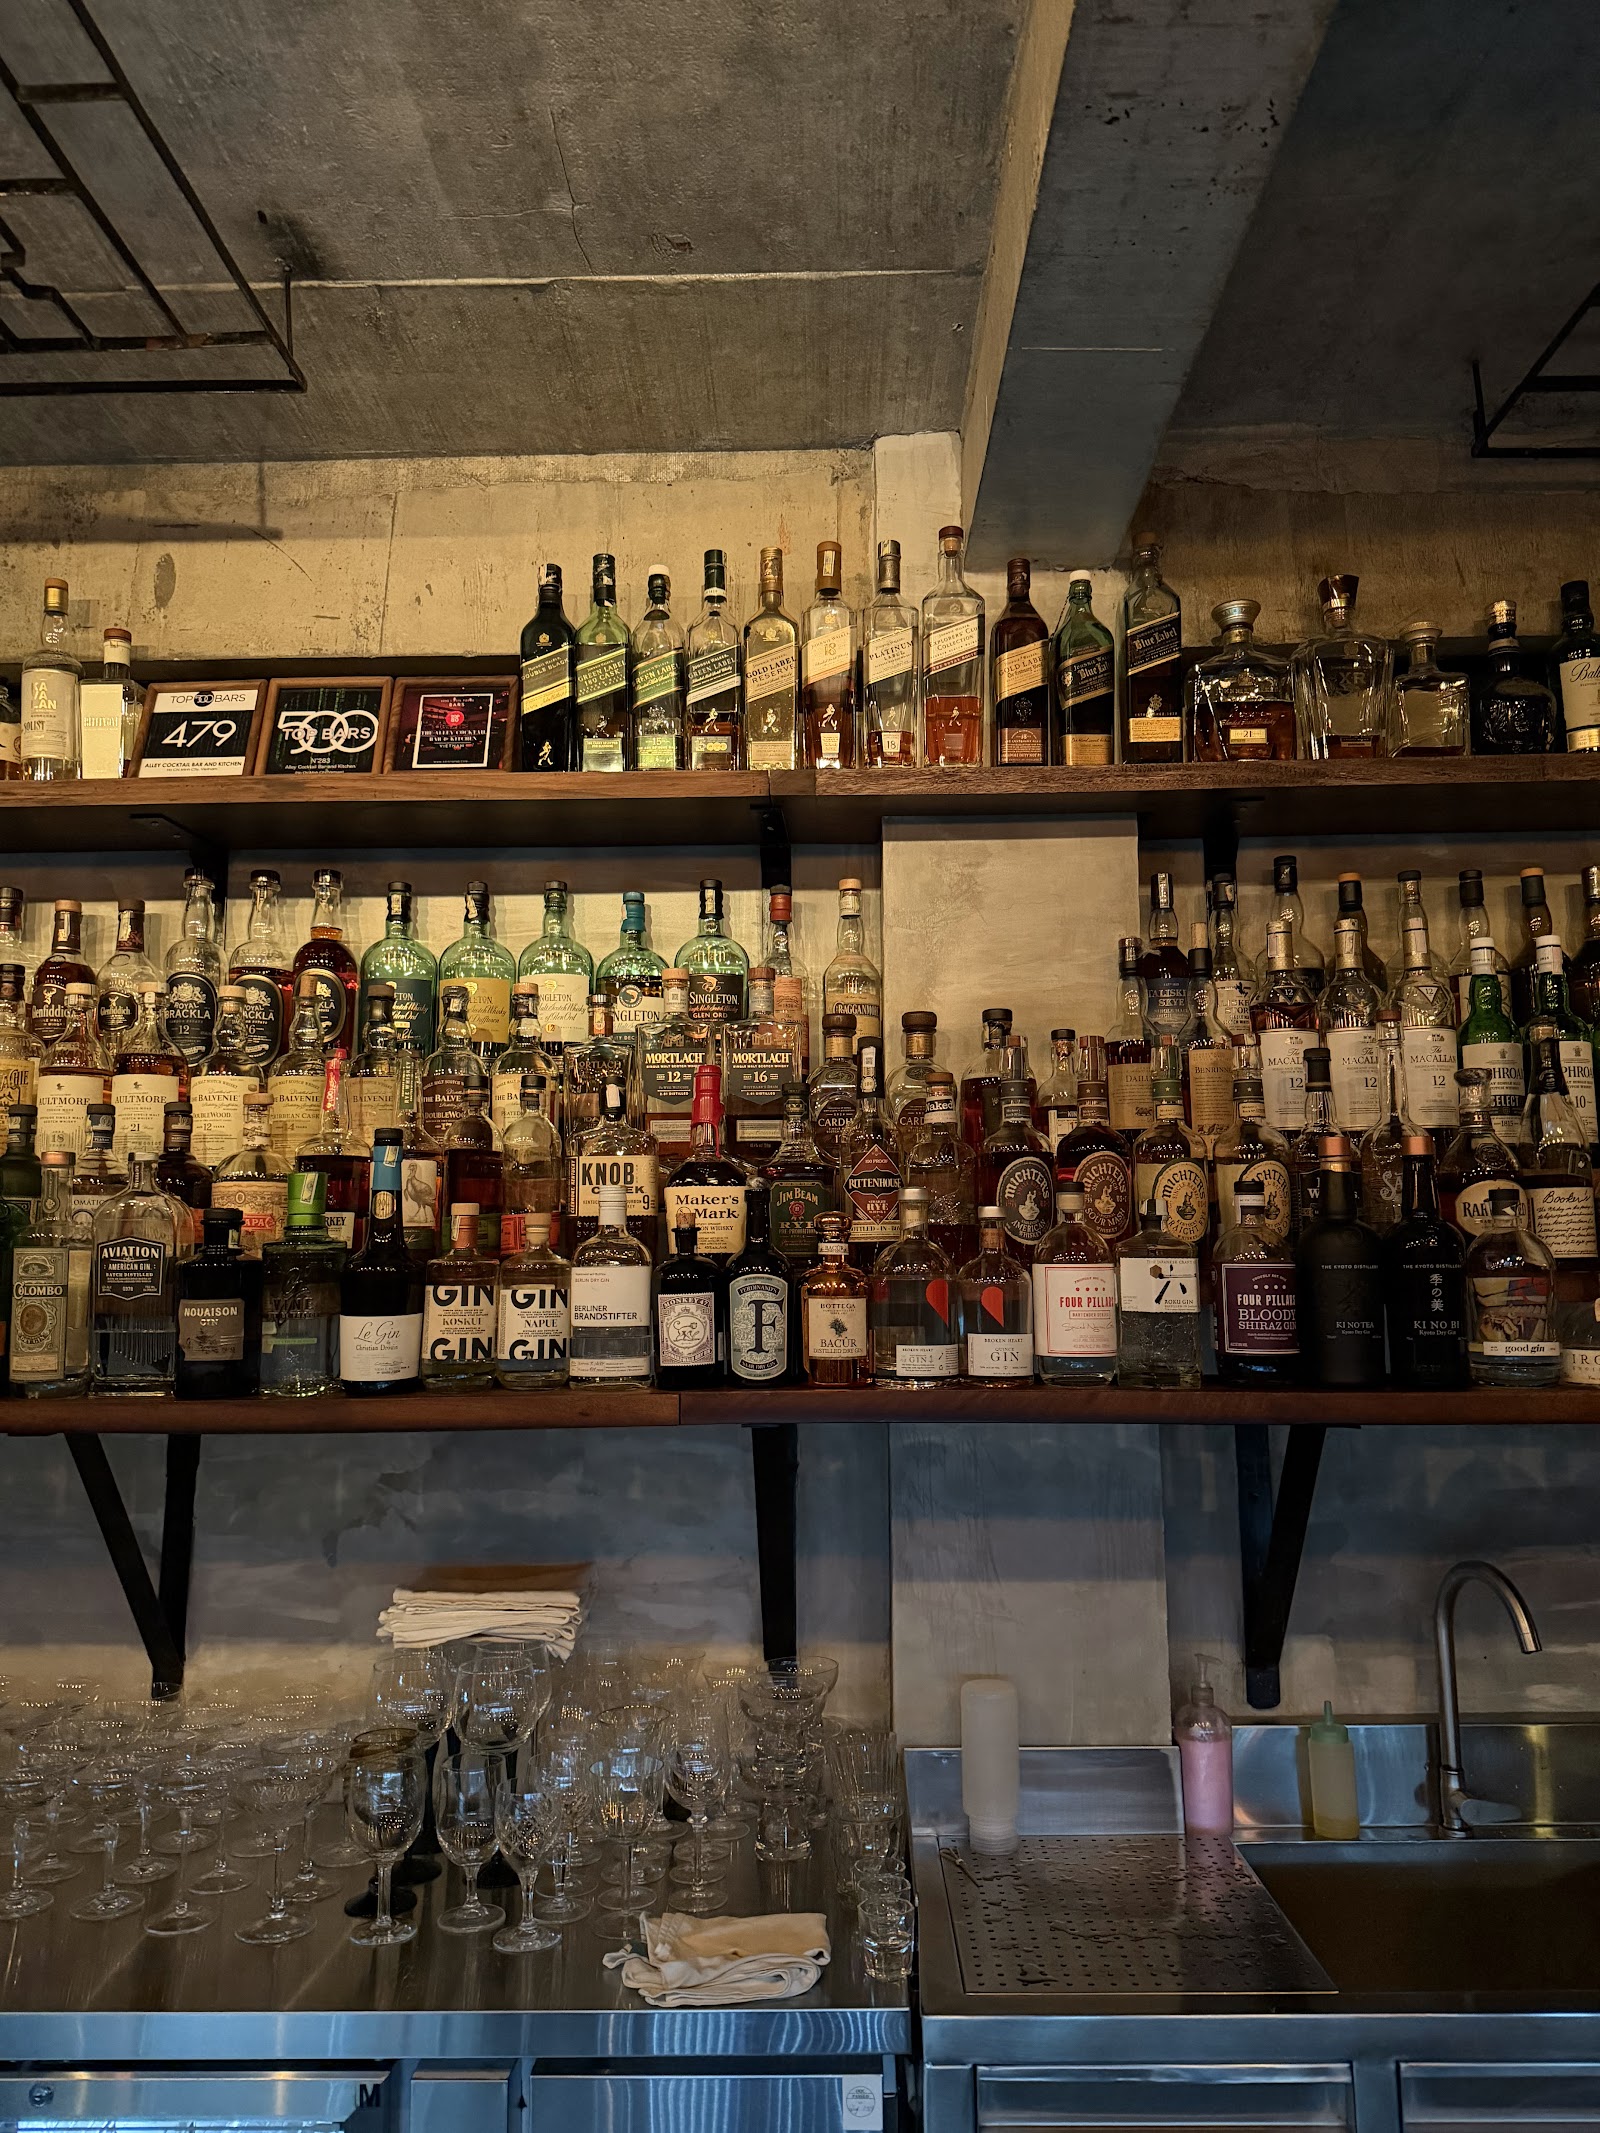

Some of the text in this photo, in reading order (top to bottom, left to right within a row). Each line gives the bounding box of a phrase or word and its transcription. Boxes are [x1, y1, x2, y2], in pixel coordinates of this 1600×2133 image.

[937, 634, 974, 650] COLLECTION
[1133, 627, 1178, 651] Blue Label
[869, 640, 914, 660] PLATINUM
[521, 657, 569, 680] DOUBLE BLACK
[578, 660, 626, 681] GREEN LABEL
[688, 666, 712, 679] GREEN
[714, 658, 736, 669] LABEL
[745, 665, 768, 679] GOLD
[769, 656, 796, 670] LABEL
[752, 664, 795, 683] RESERVE
[1077, 667, 1097, 681] Blue
[1339, 671, 1366, 685] XR
[171, 694, 246, 704] TOP BARS
[161, 720, 237, 748] 479
[277, 709, 379, 755] 500
[282, 727, 371, 740] TOP BARS
[886, 740, 897, 750] 18
[689, 991, 739, 1005] SINGLETON
[174, 1001, 200, 1010] ROYAL
[613, 1010, 660, 1022] NGLETON
[178, 1025, 190, 1035] 12
[645, 1053, 706, 1064] MORTLACH
[732, 1052, 792, 1064] MORTLACH
[666, 1071, 681, 1083] 12
[753, 1071, 768, 1083] 16
[1289, 1077, 1304, 1088] 12
[1364, 1076, 1378, 1088] 12
[1431, 1074, 1446, 1086] 12
[38, 1097, 91, 1106] AULTMORE
[115, 1095, 167, 1104] AULTMORE
[198, 1094, 239, 1102] BALVENIE
[279, 1094, 320, 1103] BALVENIE
[353, 1095, 394, 1103] BALVENIE
[1575, 1095, 1586, 1108] 10
[130, 1123, 140, 1132] 21
[203, 1123, 213, 1131] 12
[51, 1133, 65, 1144] 18
[582, 1162, 635, 1186] KNOB
[592, 1186, 645, 1194] CEK
[848, 1178, 901, 1190] RITTENHOUSE
[1004, 1168, 1050, 1200] MICHTER'S
[1162, 1169, 1206, 1200] MICHTER'S
[642, 1194, 650, 1211] 9
[675, 1194, 740, 1206] Maker's
[776, 1187, 818, 1207] JIM BEAM
[866, 1203, 889, 1211] RYE
[694, 1208, 739, 1219] Mark
[1084, 1207, 1126, 1227] SOUR MASH
[779, 1221, 814, 1229] RYE
[1011, 1219, 1047, 1232] AMERICAN
[1019, 1230, 1042, 1239] WHISKEY
[101, 1246, 160, 1259] AVIATION
[13, 1282, 63, 1300] COLOMBO
[739, 1284, 778, 1295] FERDINAND'S
[1429, 1273, 1444, 1312] 季の美
[432, 1285, 494, 1307] GIN
[511, 1290, 568, 1309] GIN
[1237, 1294, 1261, 1306] FOUR
[663, 1297, 710, 1309] MONKEY 47
[1060, 1297, 1083, 1308] FOUR
[183, 1307, 238, 1317] NOUAISON
[574, 1312, 637, 1321] BRANDSTIFTER
[1238, 1308, 1296, 1321] BLOODY
[200, 1318, 219, 1327] GIN
[524, 1319, 557, 1328] NAPUE
[747, 1297, 785, 1355] F
[1238, 1321, 1283, 1330] SHIRAZ
[1414, 1321, 1427, 1329] KI
[1430, 1321, 1448, 1329] NO
[353, 1320, 401, 1344] Le Gin
[820, 1336, 858, 1348] BACÚR
[1504, 1343, 1545, 1353] good gin
[430, 1337, 493, 1361] GIN
[509, 1338, 567, 1361] GIN
[909, 1356, 927, 1364] GIN
[990, 1351, 1020, 1362] GIN
